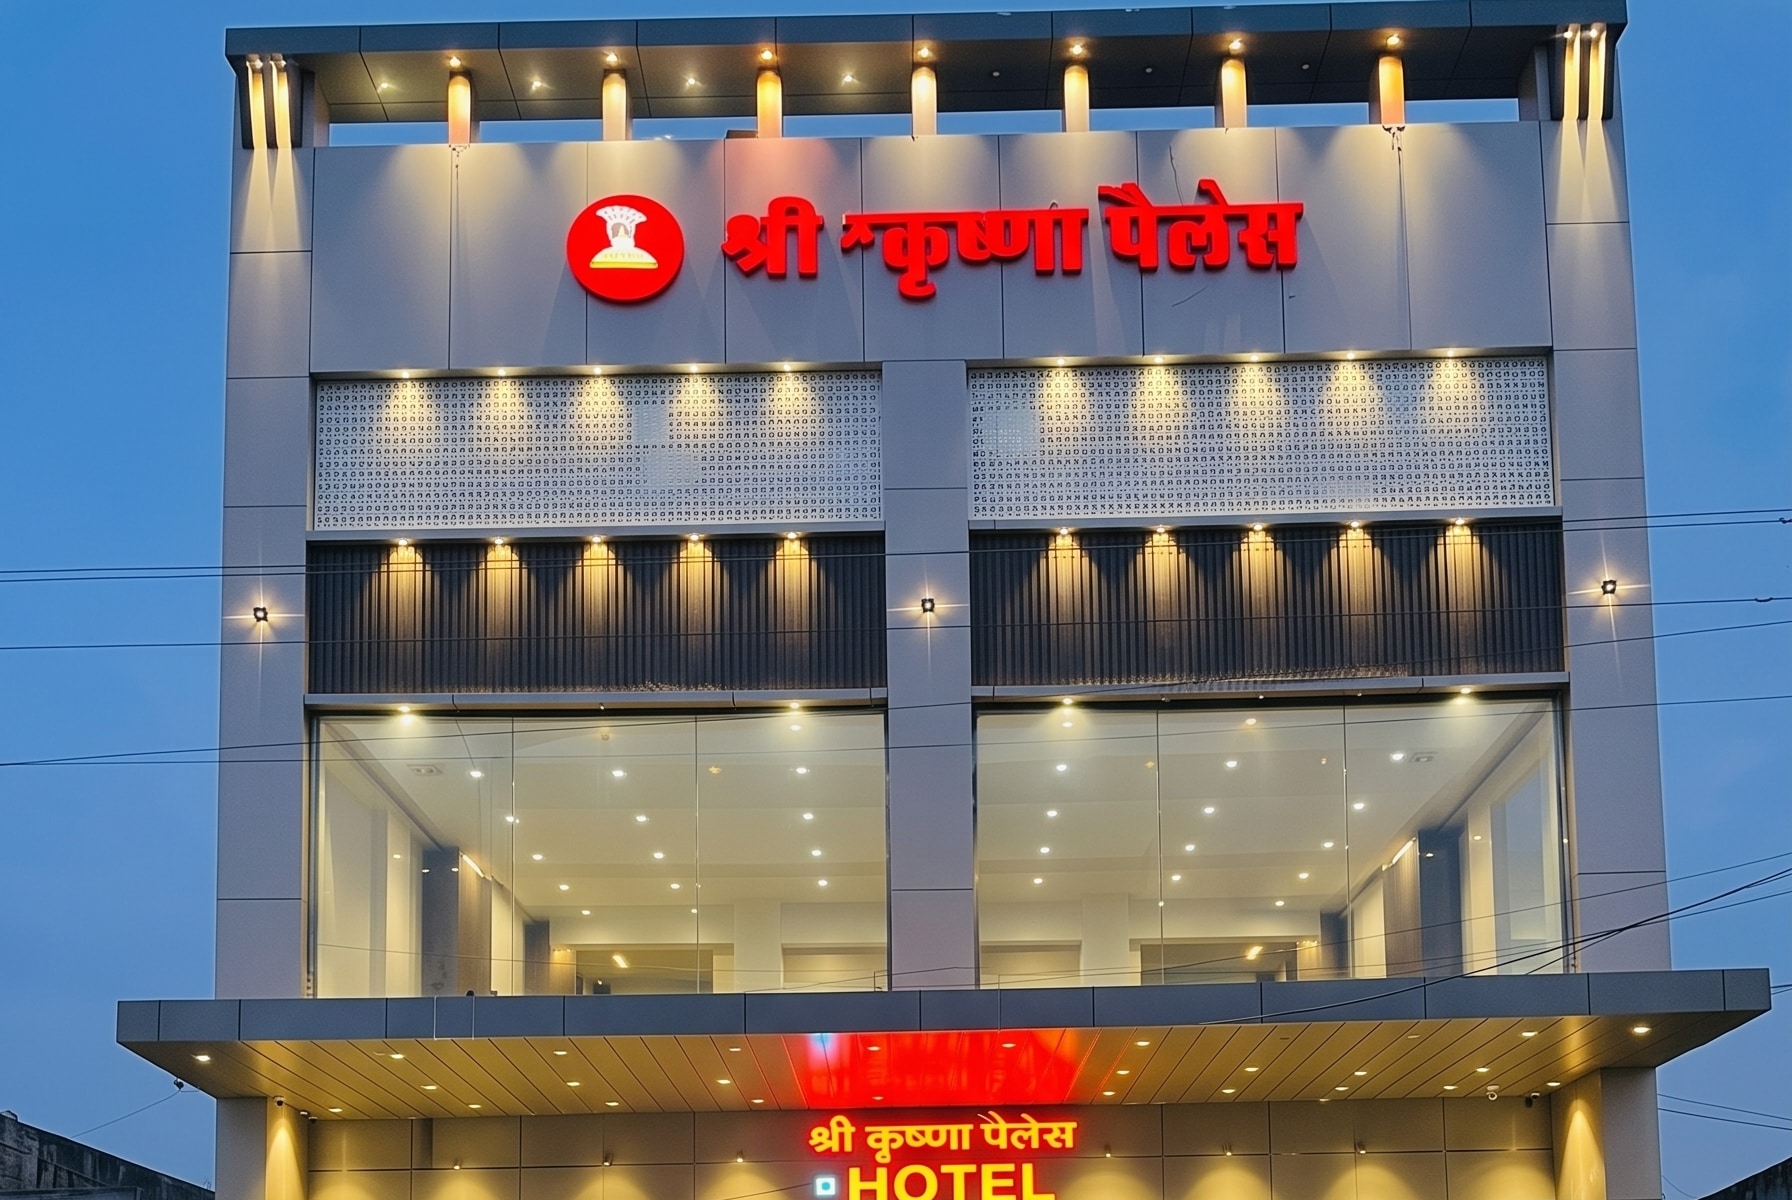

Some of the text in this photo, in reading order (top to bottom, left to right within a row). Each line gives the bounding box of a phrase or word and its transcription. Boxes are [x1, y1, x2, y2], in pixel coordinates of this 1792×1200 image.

[721, 196, 824, 277] श्री
[1098, 179, 1304, 271] पैलेस
[808, 1115, 856, 1153] श्री
[865, 1123, 974, 1164] कृष्णा
